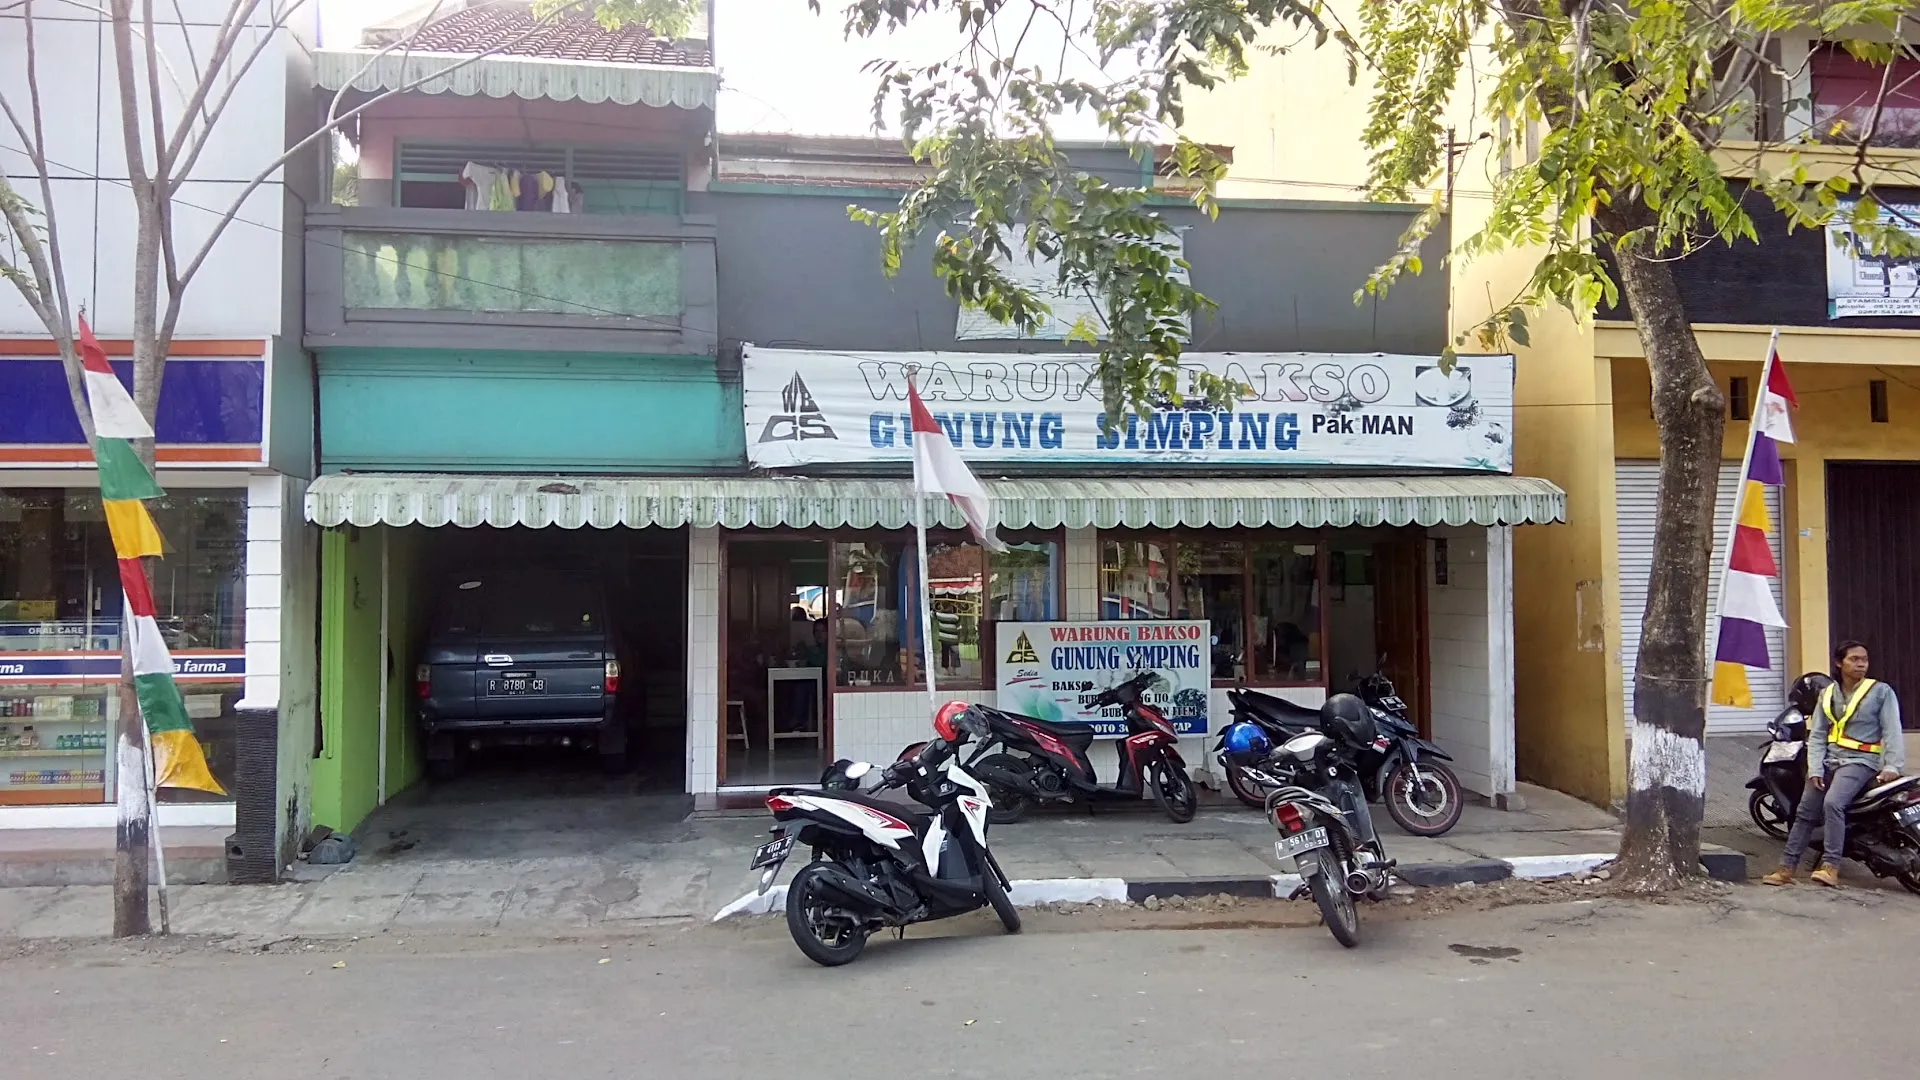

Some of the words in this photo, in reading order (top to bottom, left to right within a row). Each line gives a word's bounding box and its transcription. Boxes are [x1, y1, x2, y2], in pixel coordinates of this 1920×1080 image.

[858, 362, 1104, 402] WARUN
[1312, 414, 1354, 434] Pak
[1361, 415, 1414, 436] MAN
[57, 626, 84, 634] CARE
[1050, 626, 1130, 642] WARUNG
[1137, 625, 1201, 641] BAKSO
[184, 659, 226, 673] farma
[1051, 646, 1119, 670] GUNUNG
[1126, 645, 1200, 669] SIMPING
[1016, 669, 1038, 677] Sedia
[489, 680, 496, 691] R
[503, 680, 526, 691] 8780
[532, 680, 544, 690] CB
[1277, 842, 1284, 851] R
[1290, 834, 1308, 846] 5611
[1315, 829, 1325, 838] DT
